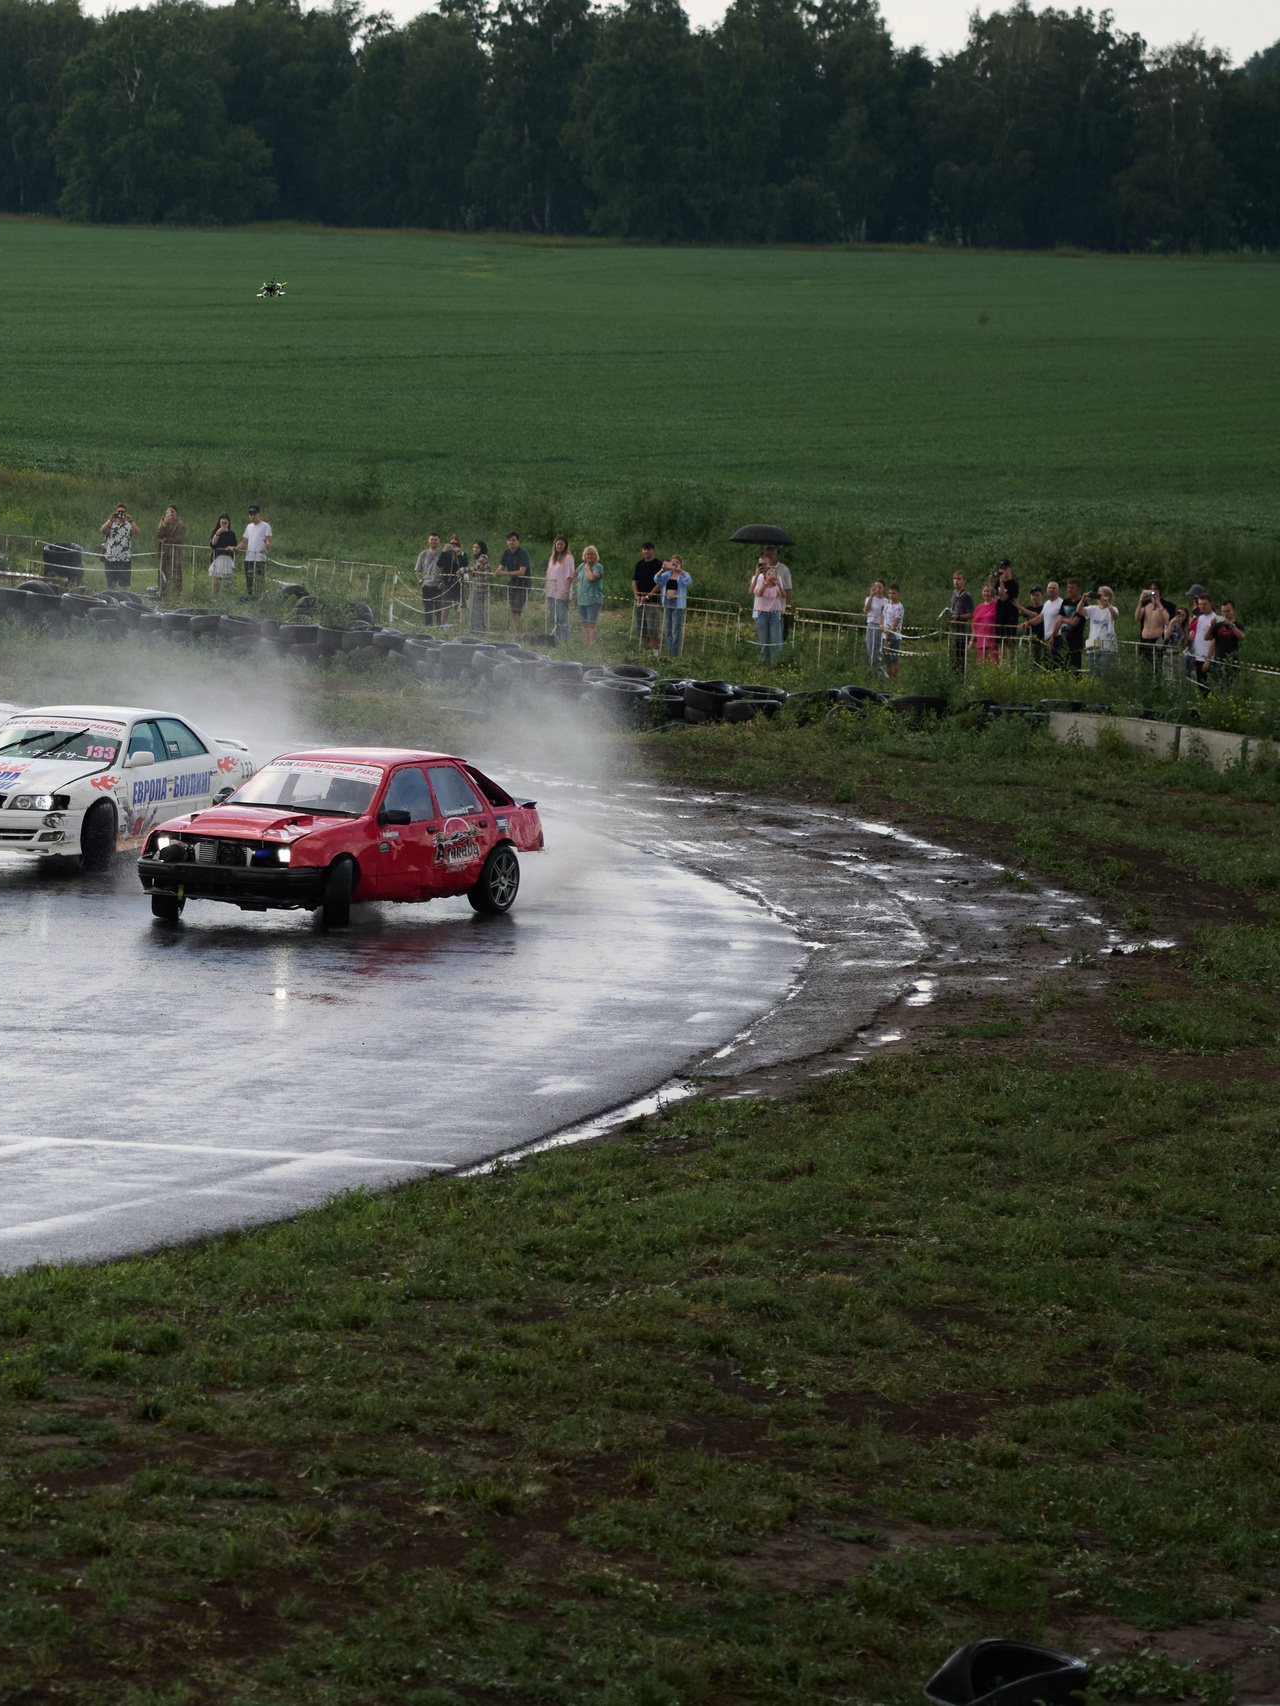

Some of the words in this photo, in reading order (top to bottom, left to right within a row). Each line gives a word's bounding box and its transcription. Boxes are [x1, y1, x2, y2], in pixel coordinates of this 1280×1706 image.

[86, 745, 116, 760] 133
[240, 761, 253, 779] 133
[133, 777, 167, 804] ЕВРОПА
[174, 771, 212, 798] БОУЛИНГ
